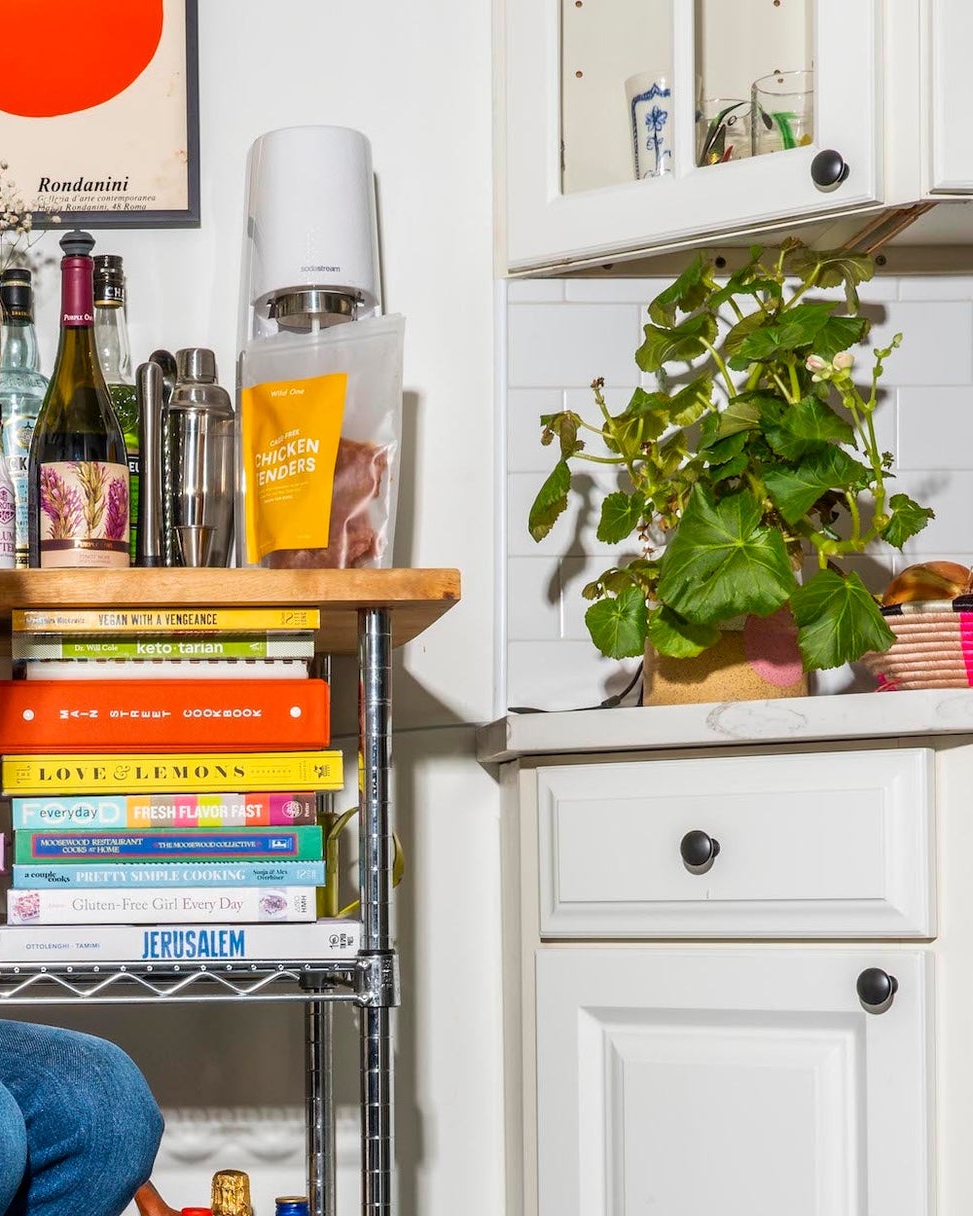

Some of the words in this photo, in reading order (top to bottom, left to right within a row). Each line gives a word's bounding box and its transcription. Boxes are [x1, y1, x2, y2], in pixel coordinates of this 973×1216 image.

[37, 176, 129, 193] Rondanini
[97, 194, 156, 203] contemporanea
[270, 390, 288, 398] Wild
[289, 388, 305, 396] One
[255, 438, 320, 468] CHICKEN
[256, 457, 317, 487] ENDERS
[98, 614, 128, 625] VEGAN
[131, 614, 153, 625] WITH
[155, 614, 162, 624] A
[165, 613, 218, 625] VENGEANCE
[59, 709, 99, 719] MAIN
[109, 709, 172, 719] STREET
[183, 708, 262, 718] COOKBOOK
[40, 767, 106, 780] LOVE
[113, 765, 131, 781] &
[136, 766, 245, 779] LEMONS
[22, 801, 121, 825] FOOD
[39, 806, 98, 820] everyday
[133, 806, 176, 820] FRESH
[179, 805, 229, 819] FLAVOR
[231, 804, 263, 818] FAST
[40, 838, 89, 846] MOOSEWOOD
[92, 838, 144, 846] RESTAURANT
[30, 871, 57, 880] couple
[76, 871, 127, 882] PRETTY
[130, 870, 180, 882] SIMPLE
[183, 870, 246, 881] COOKING
[72, 898, 148, 911] Gluten-Free
[152, 897, 178, 910] Girl
[183, 898, 216, 913] Every
[219, 897, 244, 913] Day
[142, 929, 246, 959] JERUSALEM
